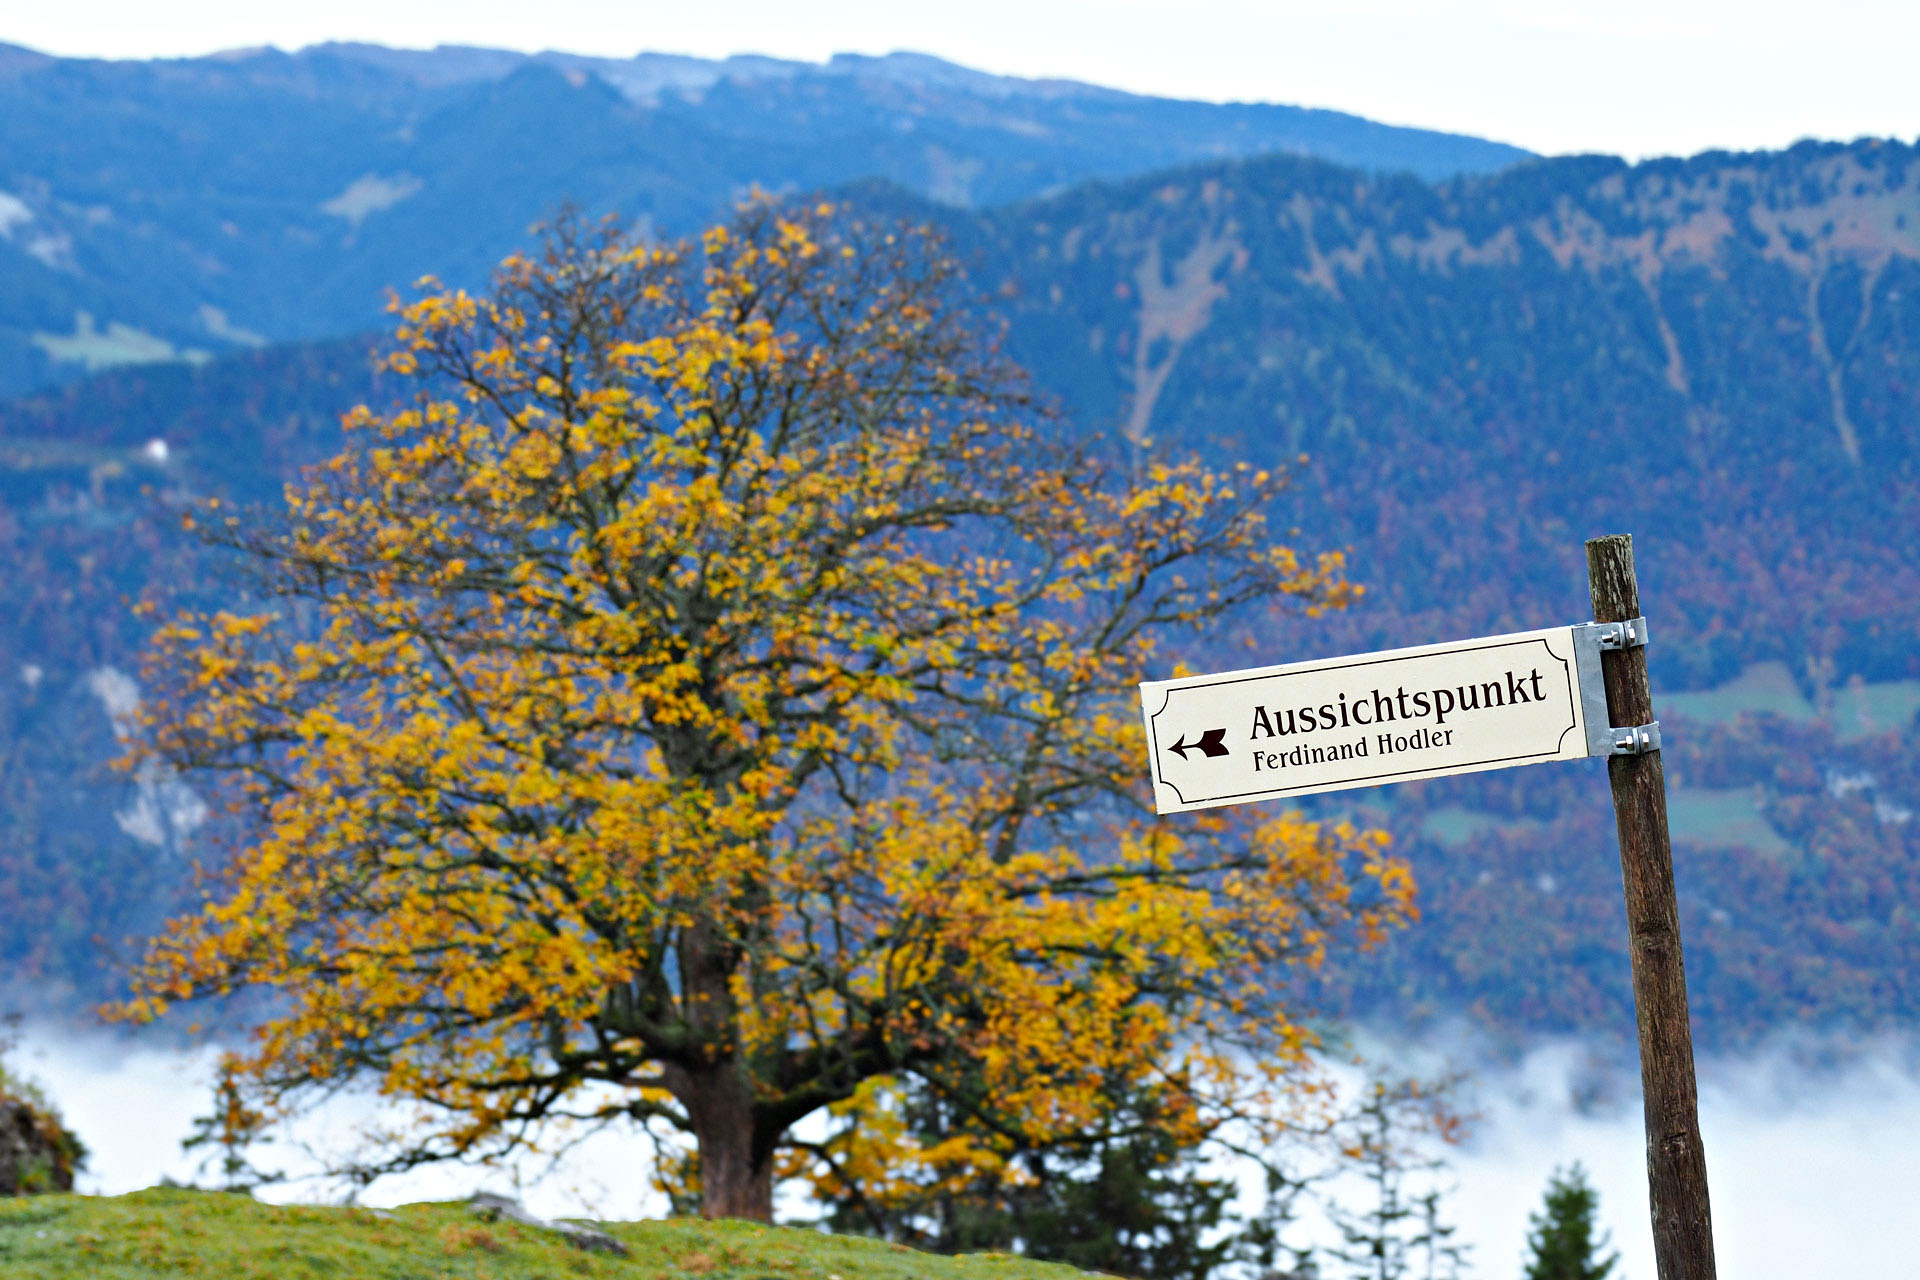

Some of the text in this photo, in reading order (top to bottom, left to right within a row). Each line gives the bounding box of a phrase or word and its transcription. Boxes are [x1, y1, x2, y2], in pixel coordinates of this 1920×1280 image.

[1249, 668, 1547, 740] Aussichtspunkt
[1252, 728, 1453, 772] Ferdinand Hodler
